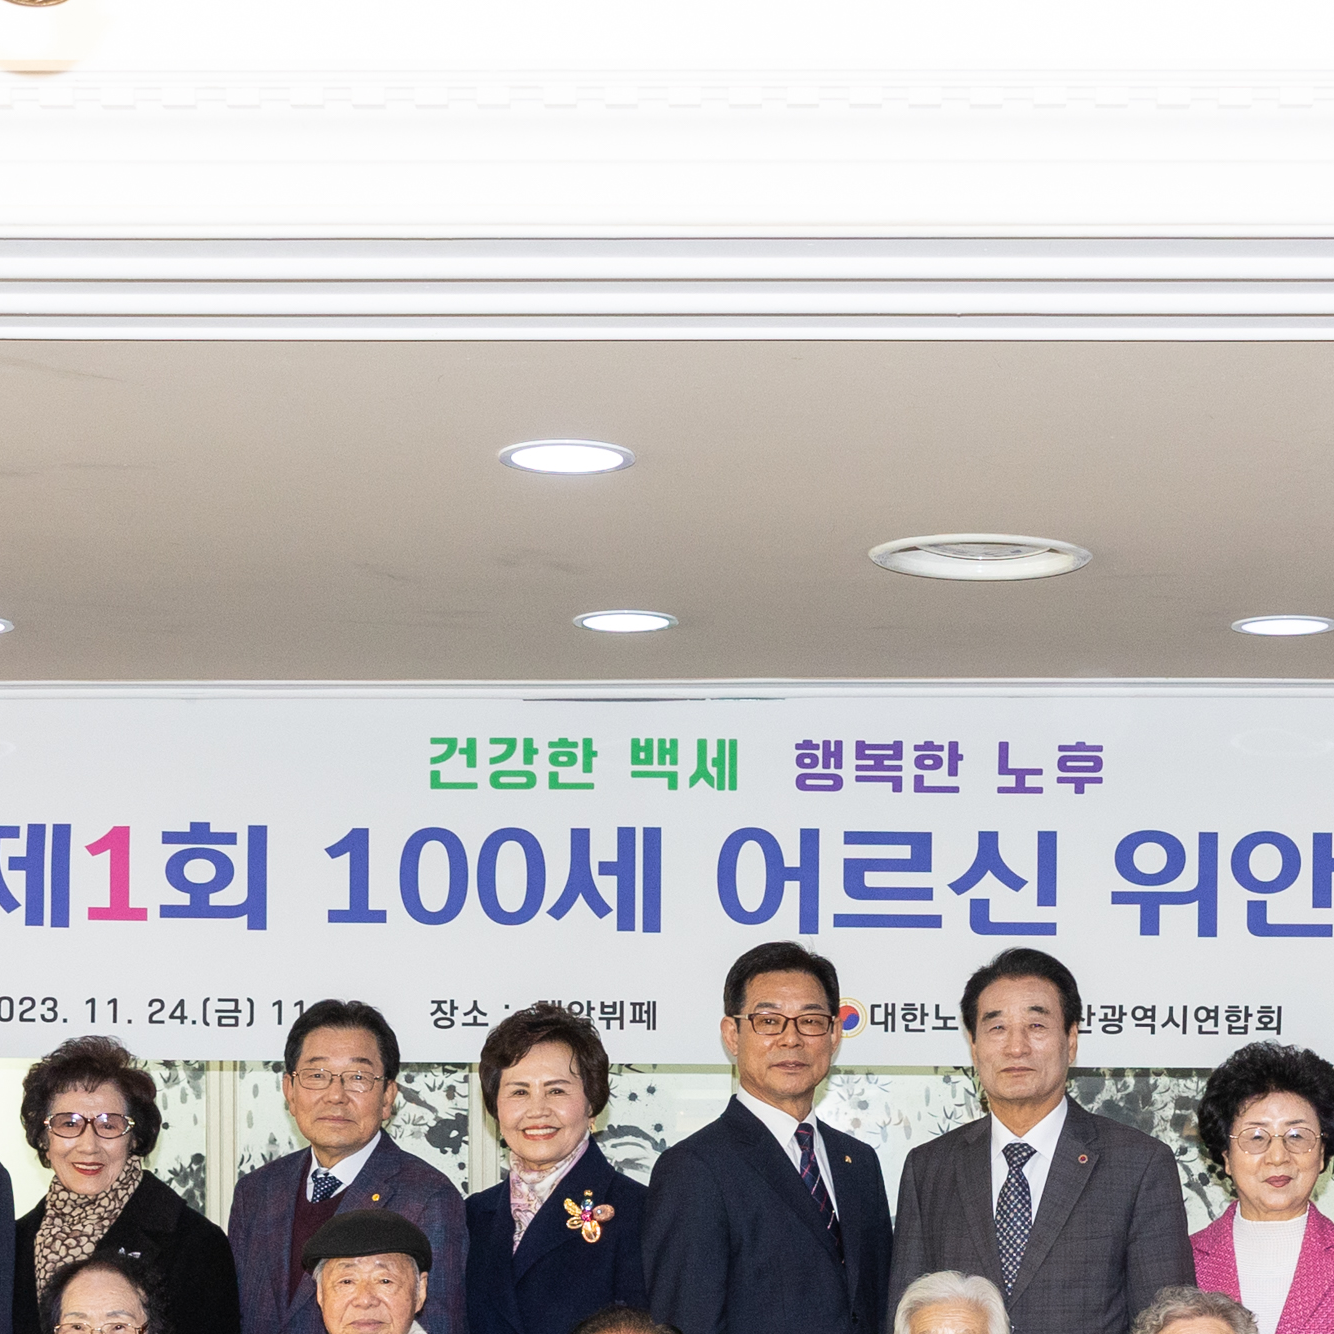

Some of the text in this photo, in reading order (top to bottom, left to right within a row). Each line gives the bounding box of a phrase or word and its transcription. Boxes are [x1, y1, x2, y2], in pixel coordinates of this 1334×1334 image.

[431, 738, 1105, 796] 건강한 백세 행복한 노후
[325, 826, 662, 935] 100세
[717, 826, 1059, 937] 어르신
[429, 999, 489, 1030] 장소
[1078, 1004, 1283, 1036] 산광역시연합회
